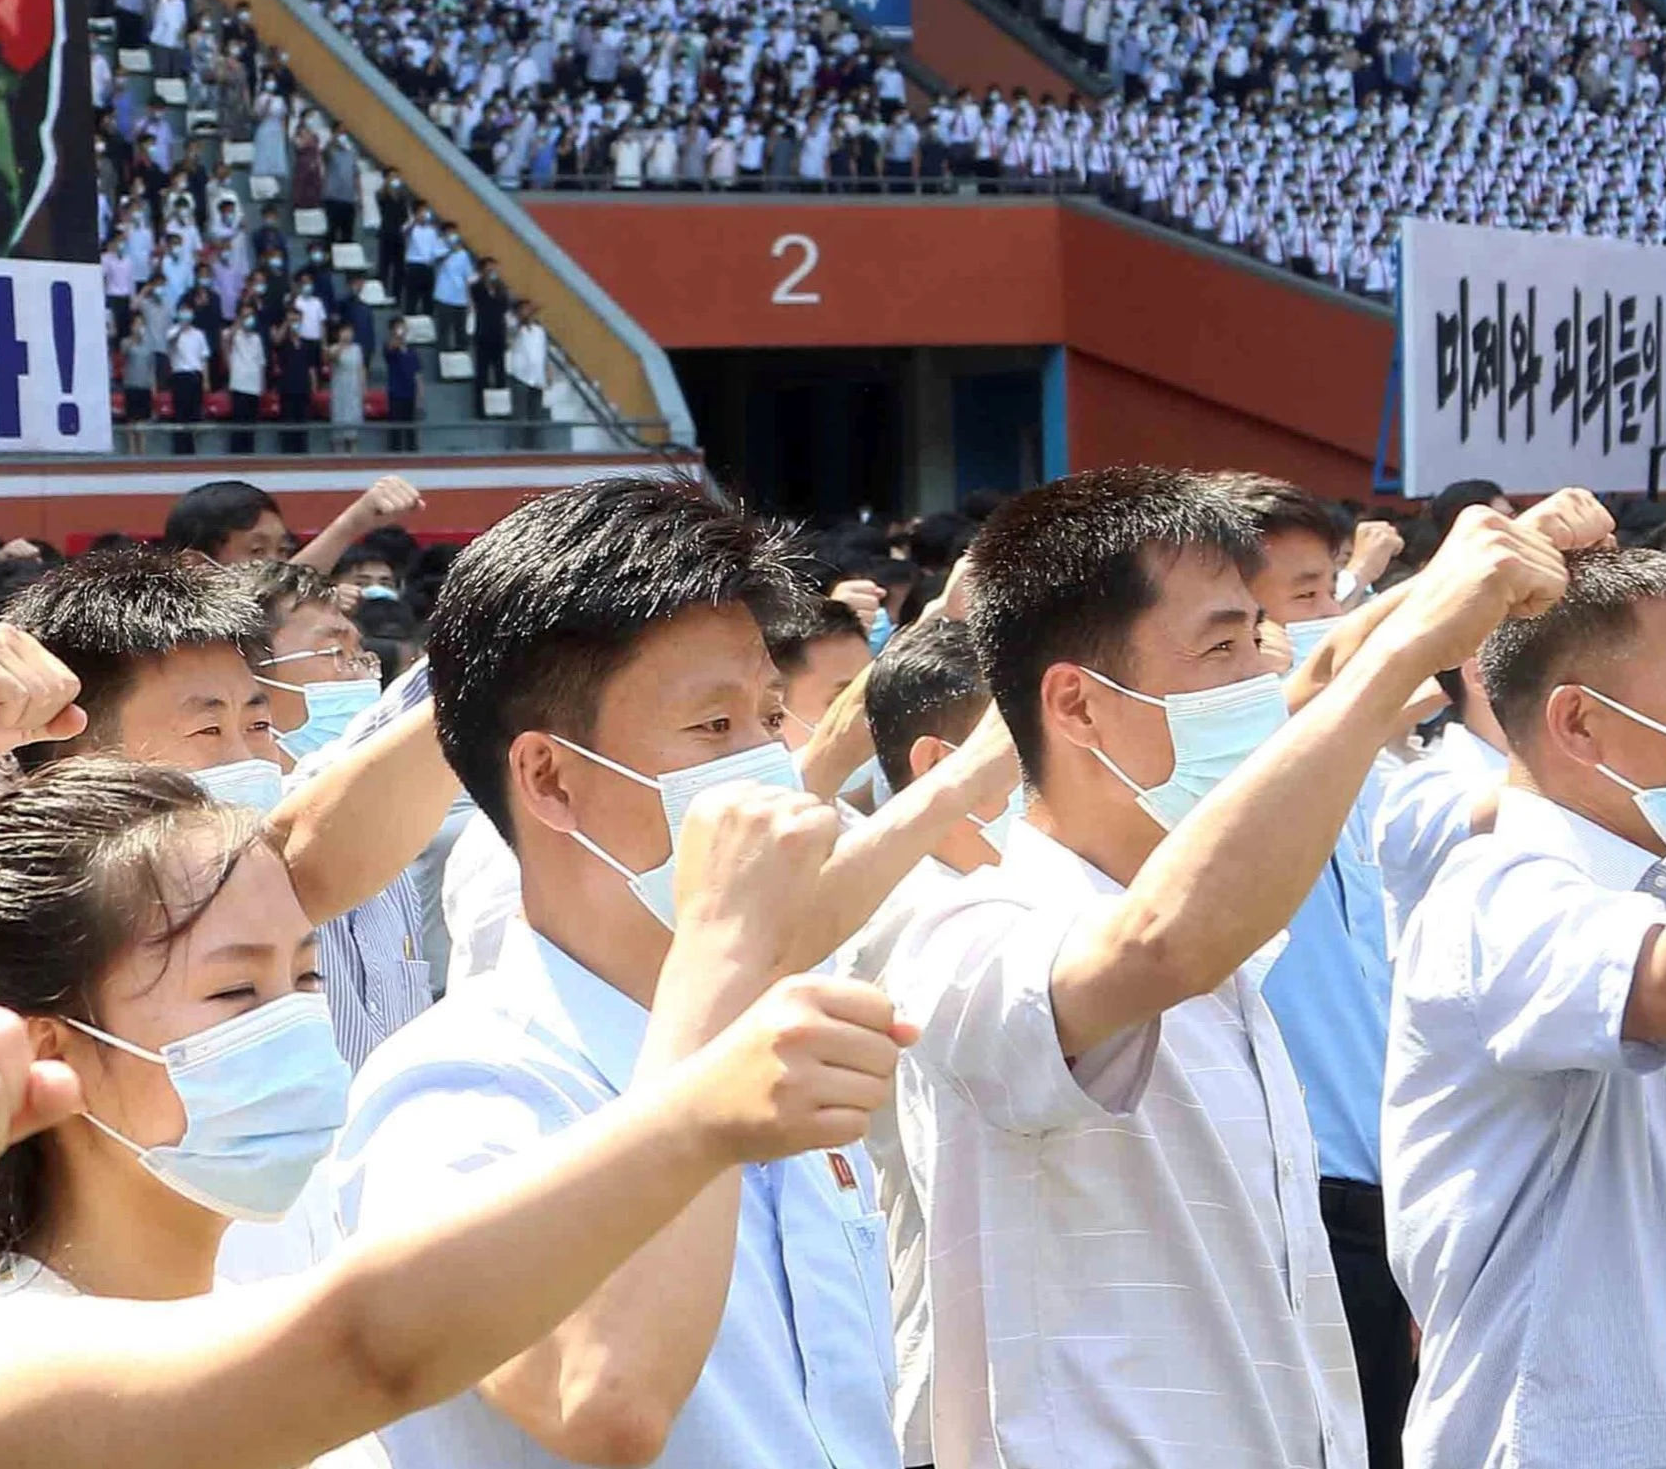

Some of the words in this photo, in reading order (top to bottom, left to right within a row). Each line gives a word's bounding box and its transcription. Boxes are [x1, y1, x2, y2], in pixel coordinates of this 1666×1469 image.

[771, 233, 820, 304] 2
[1435, 276, 1544, 444] 미제와
[1550, 285, 1665, 456] 괴뢰들의
